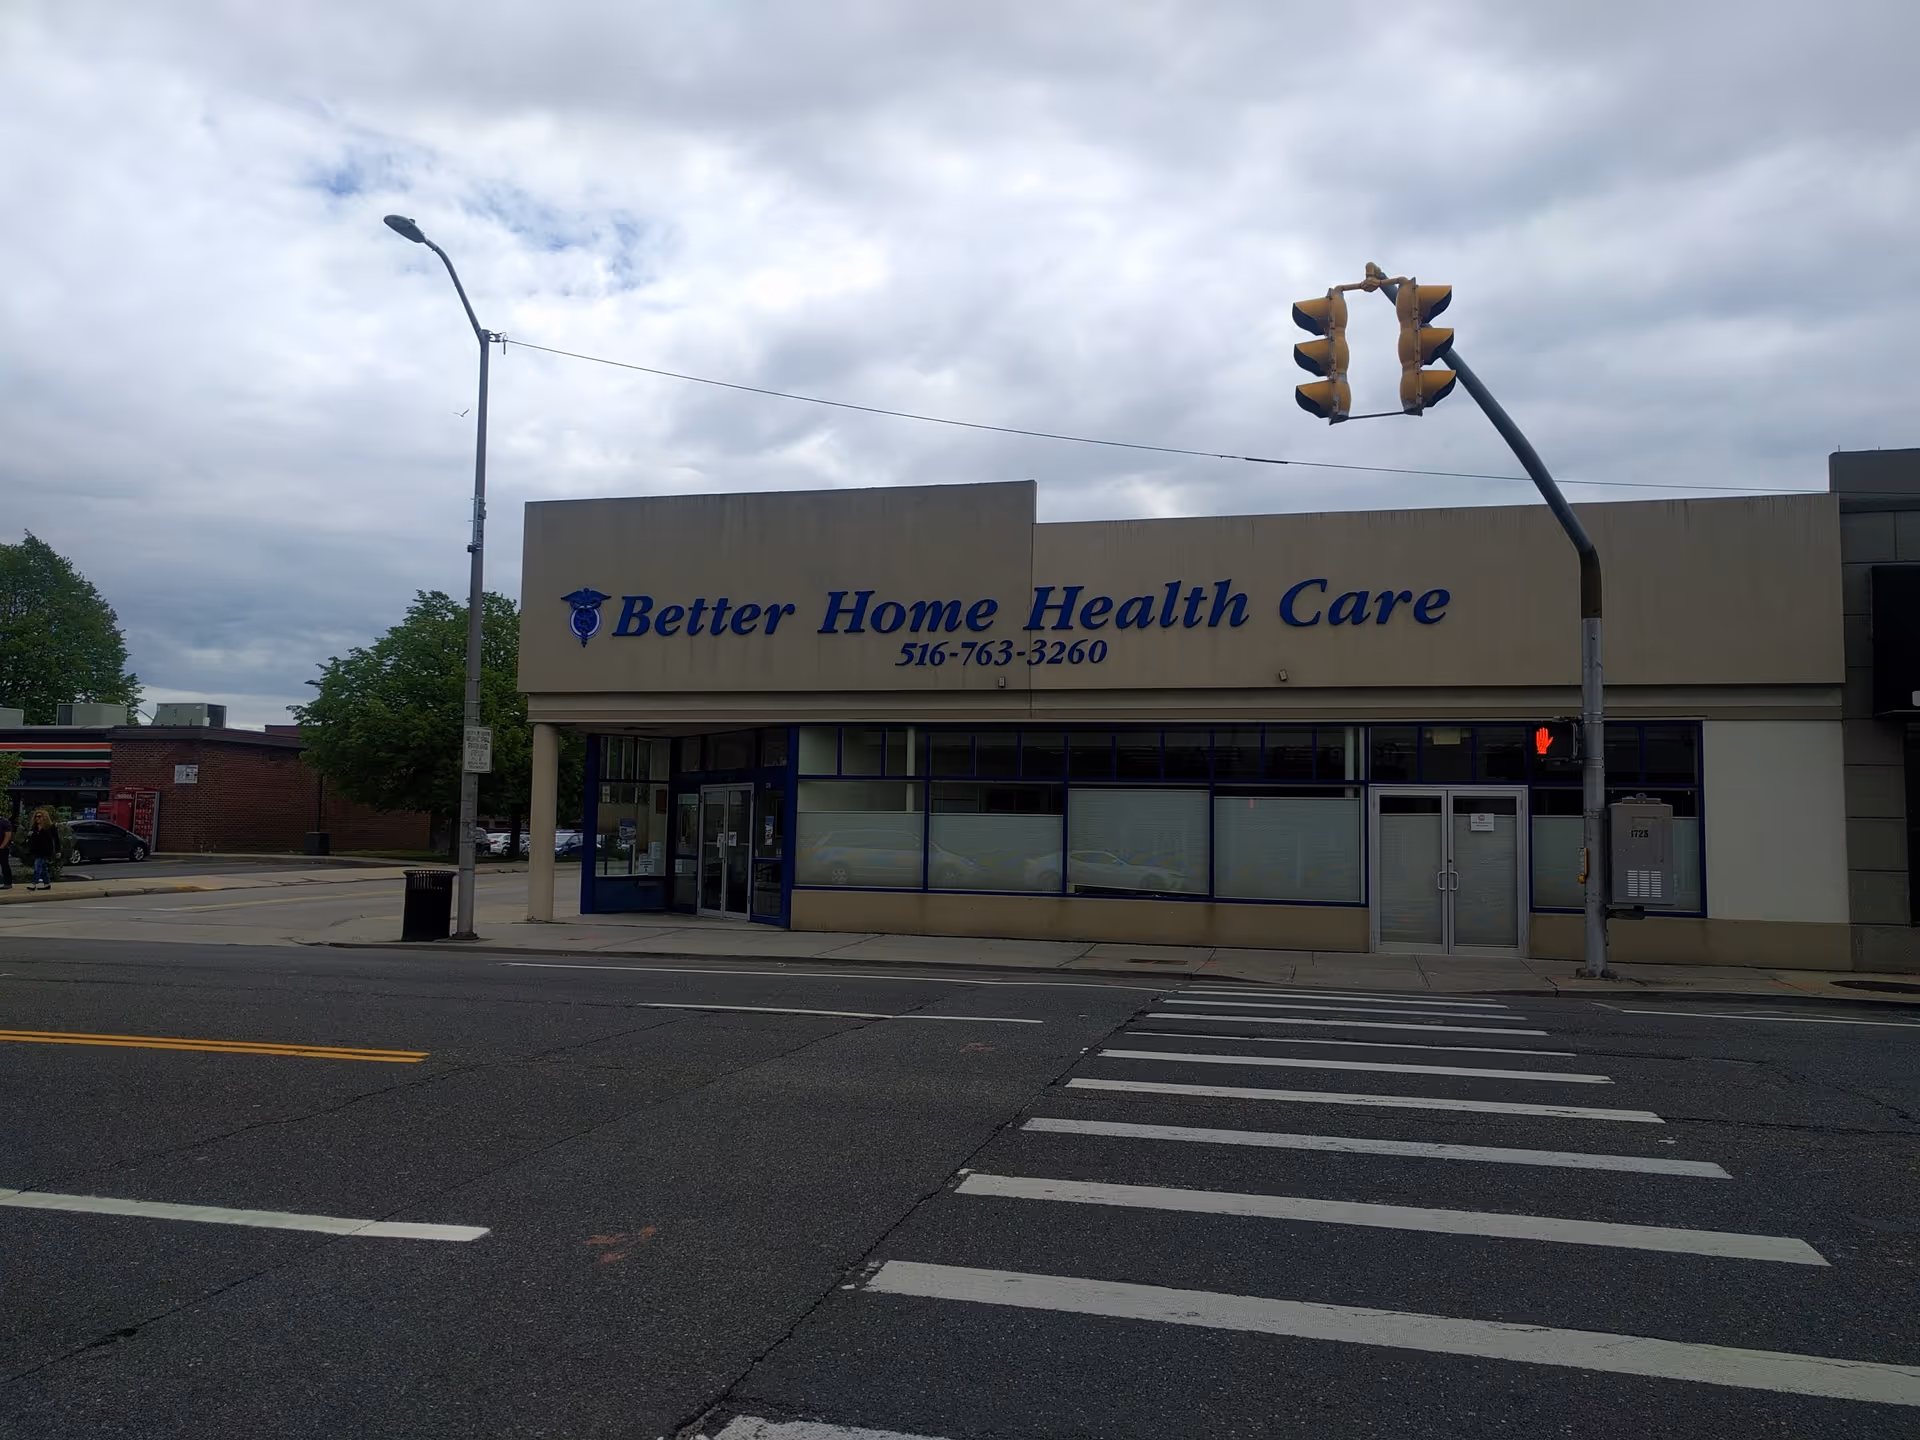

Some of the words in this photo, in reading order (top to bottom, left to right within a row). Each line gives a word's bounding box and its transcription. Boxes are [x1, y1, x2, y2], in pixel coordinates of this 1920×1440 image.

[611, 593, 796, 638] Better
[817, 588, 1000, 635] Home
[1022, 577, 1250, 632] Health
[1279, 576, 1452, 627] Care
[895, 639, 1108, 668] 516-763-3260
